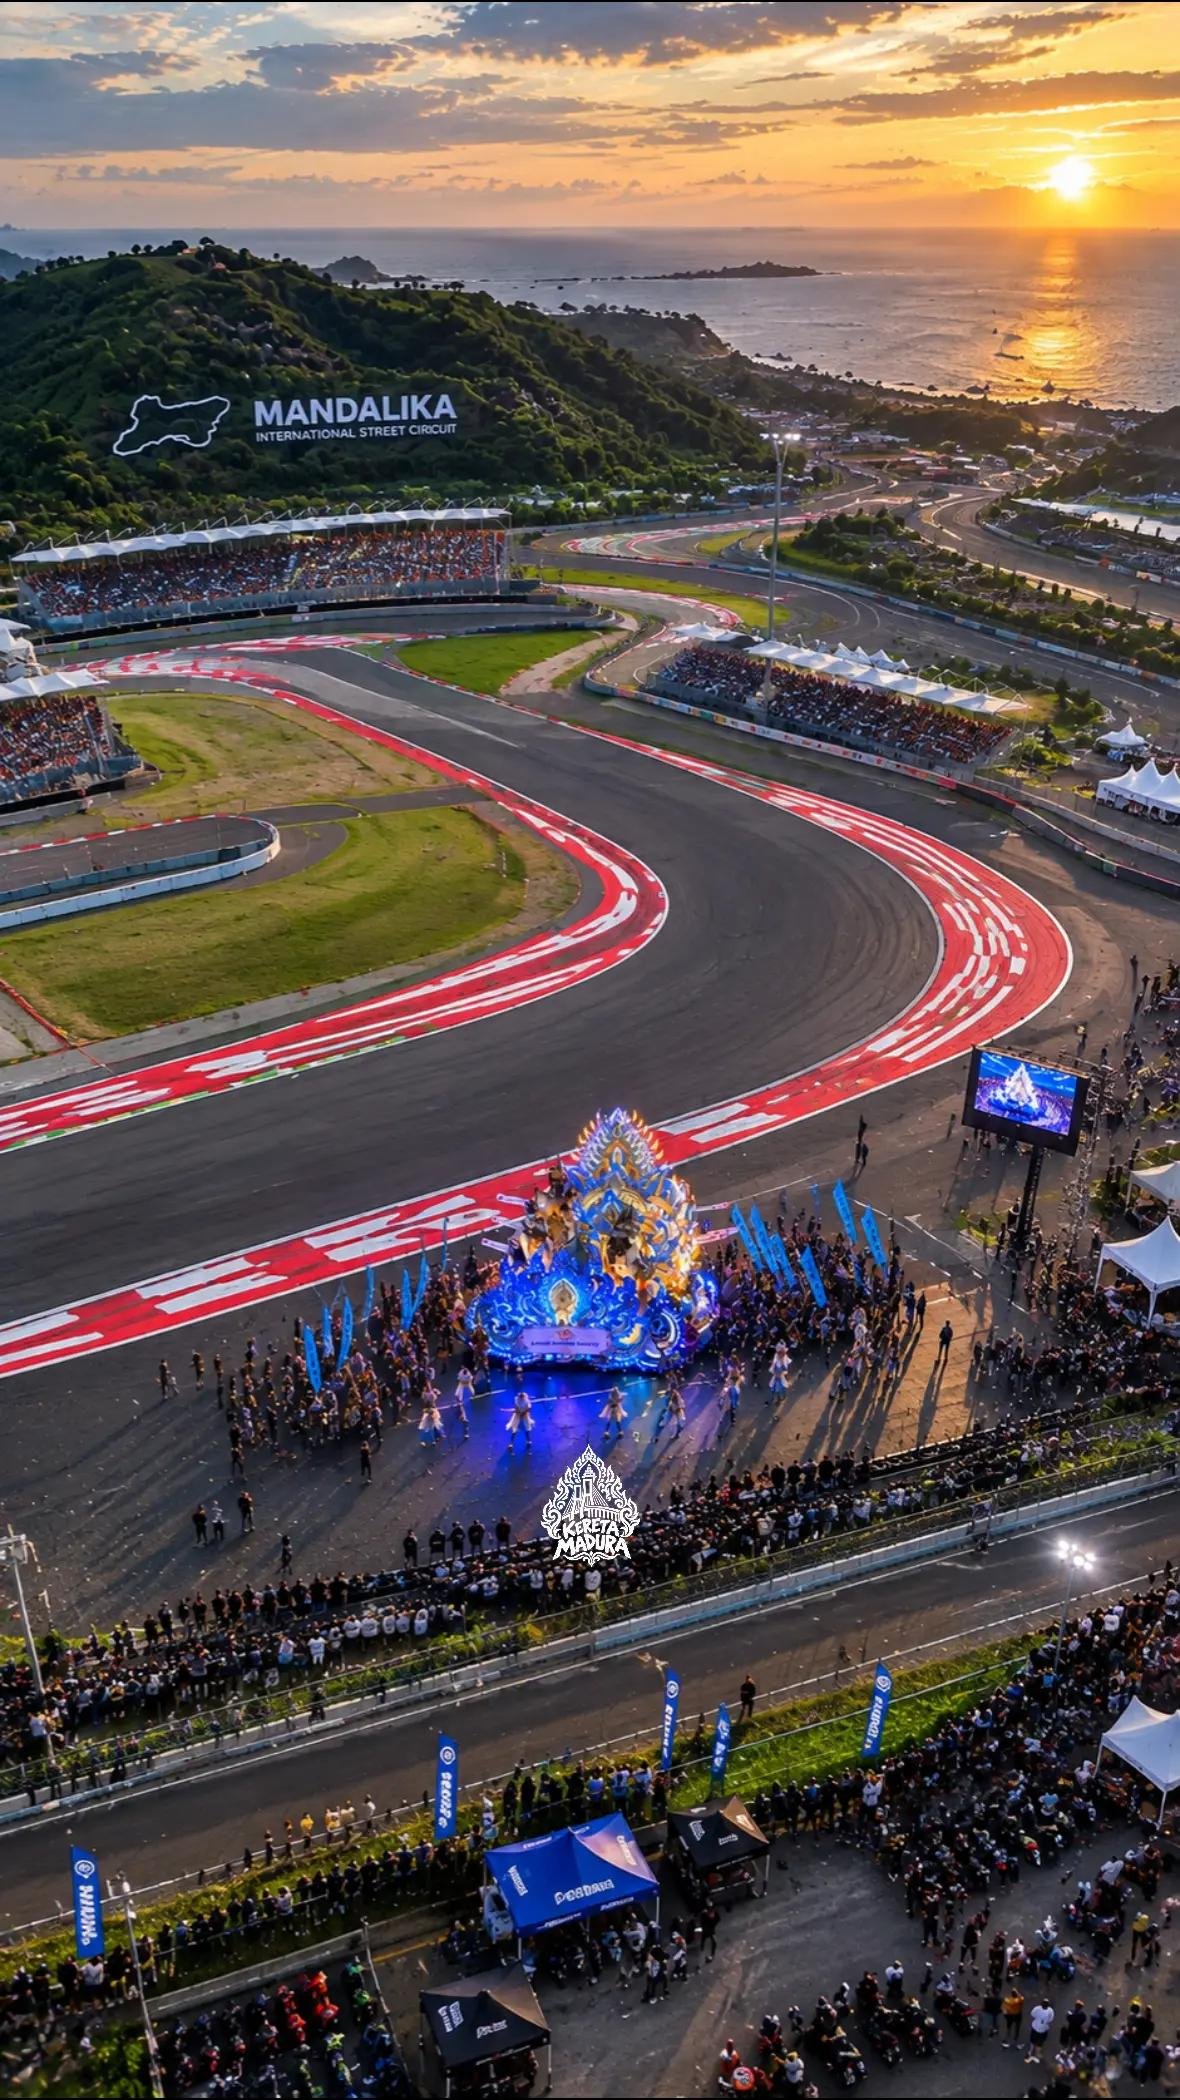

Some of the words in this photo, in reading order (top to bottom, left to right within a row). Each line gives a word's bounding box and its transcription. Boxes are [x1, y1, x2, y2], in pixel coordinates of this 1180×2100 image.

[254, 394, 458, 426] MANDALIKA
[256, 429, 356, 442] INTERNATIONAL
[360, 425, 406, 437] STREET
